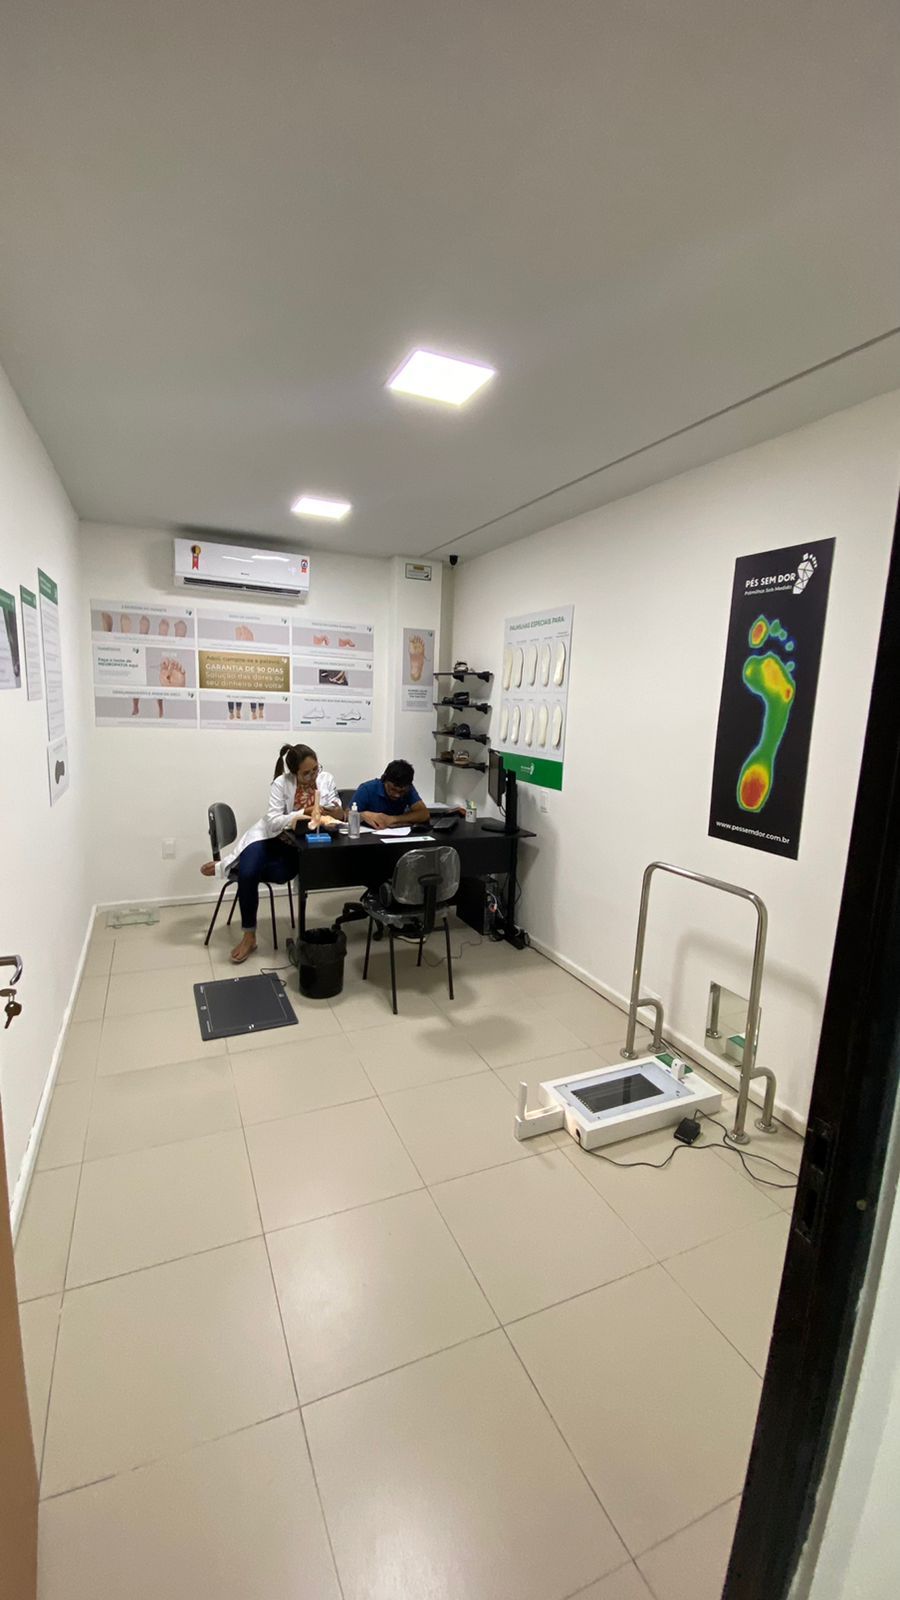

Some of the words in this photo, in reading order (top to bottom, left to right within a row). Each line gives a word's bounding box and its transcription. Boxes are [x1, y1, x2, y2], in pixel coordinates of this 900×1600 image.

[745, 577, 759, 588] PÉS
[761, 576, 777, 586] SEM
[778, 573, 796, 583] DOR
[531, 619, 551, 628] ESPECIAIS
[552, 615, 565, 623] PARA
[206, 664, 243, 672] GARANTIA
[267, 666, 284, 674] DIAS
[206, 672, 235, 680] Solução
[254, 673, 273, 681] dores
[220, 680, 252, 688] dinheiro
[716, 821, 790, 844] www.pessemdor.com.br
